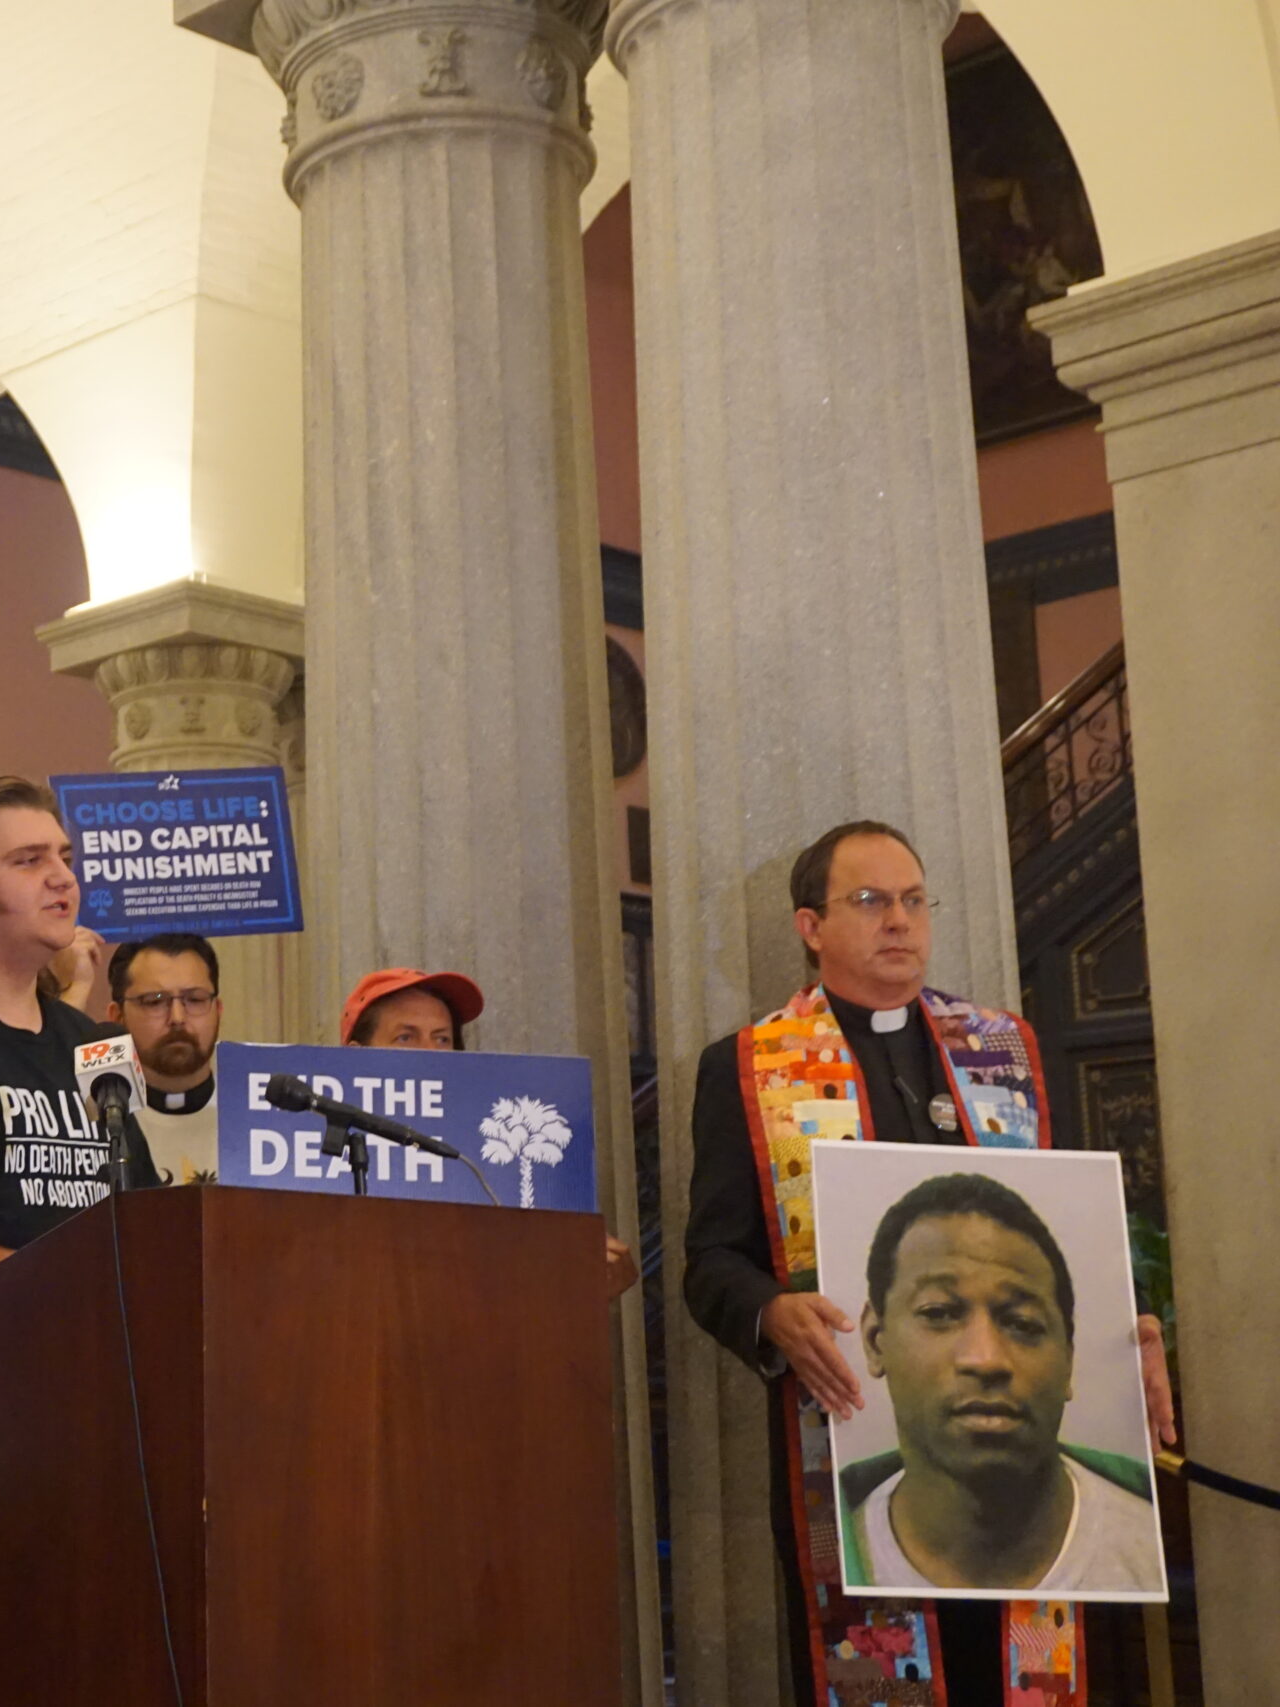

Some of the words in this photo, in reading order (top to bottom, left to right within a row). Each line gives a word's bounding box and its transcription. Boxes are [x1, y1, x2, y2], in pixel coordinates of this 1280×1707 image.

[75, 800, 195, 826] CHOOSE
[204, 797, 269, 821] LIFE:
[82, 829, 143, 854] END
[150, 823, 268, 851] CAPITAL
[83, 850, 273, 883] PUNISHMENT
[80, 1043, 110, 1061] 19
[81, 1053, 125, 1068] WLTX
[248, 1072, 344, 1111] ED
[353, 1077, 444, 1117] THE
[58, 1090, 111, 1141] LI
[4, 1144, 26, 1174] NO
[29, 1144, 72, 1175] DEATH
[20, 1178, 44, 1206] NO
